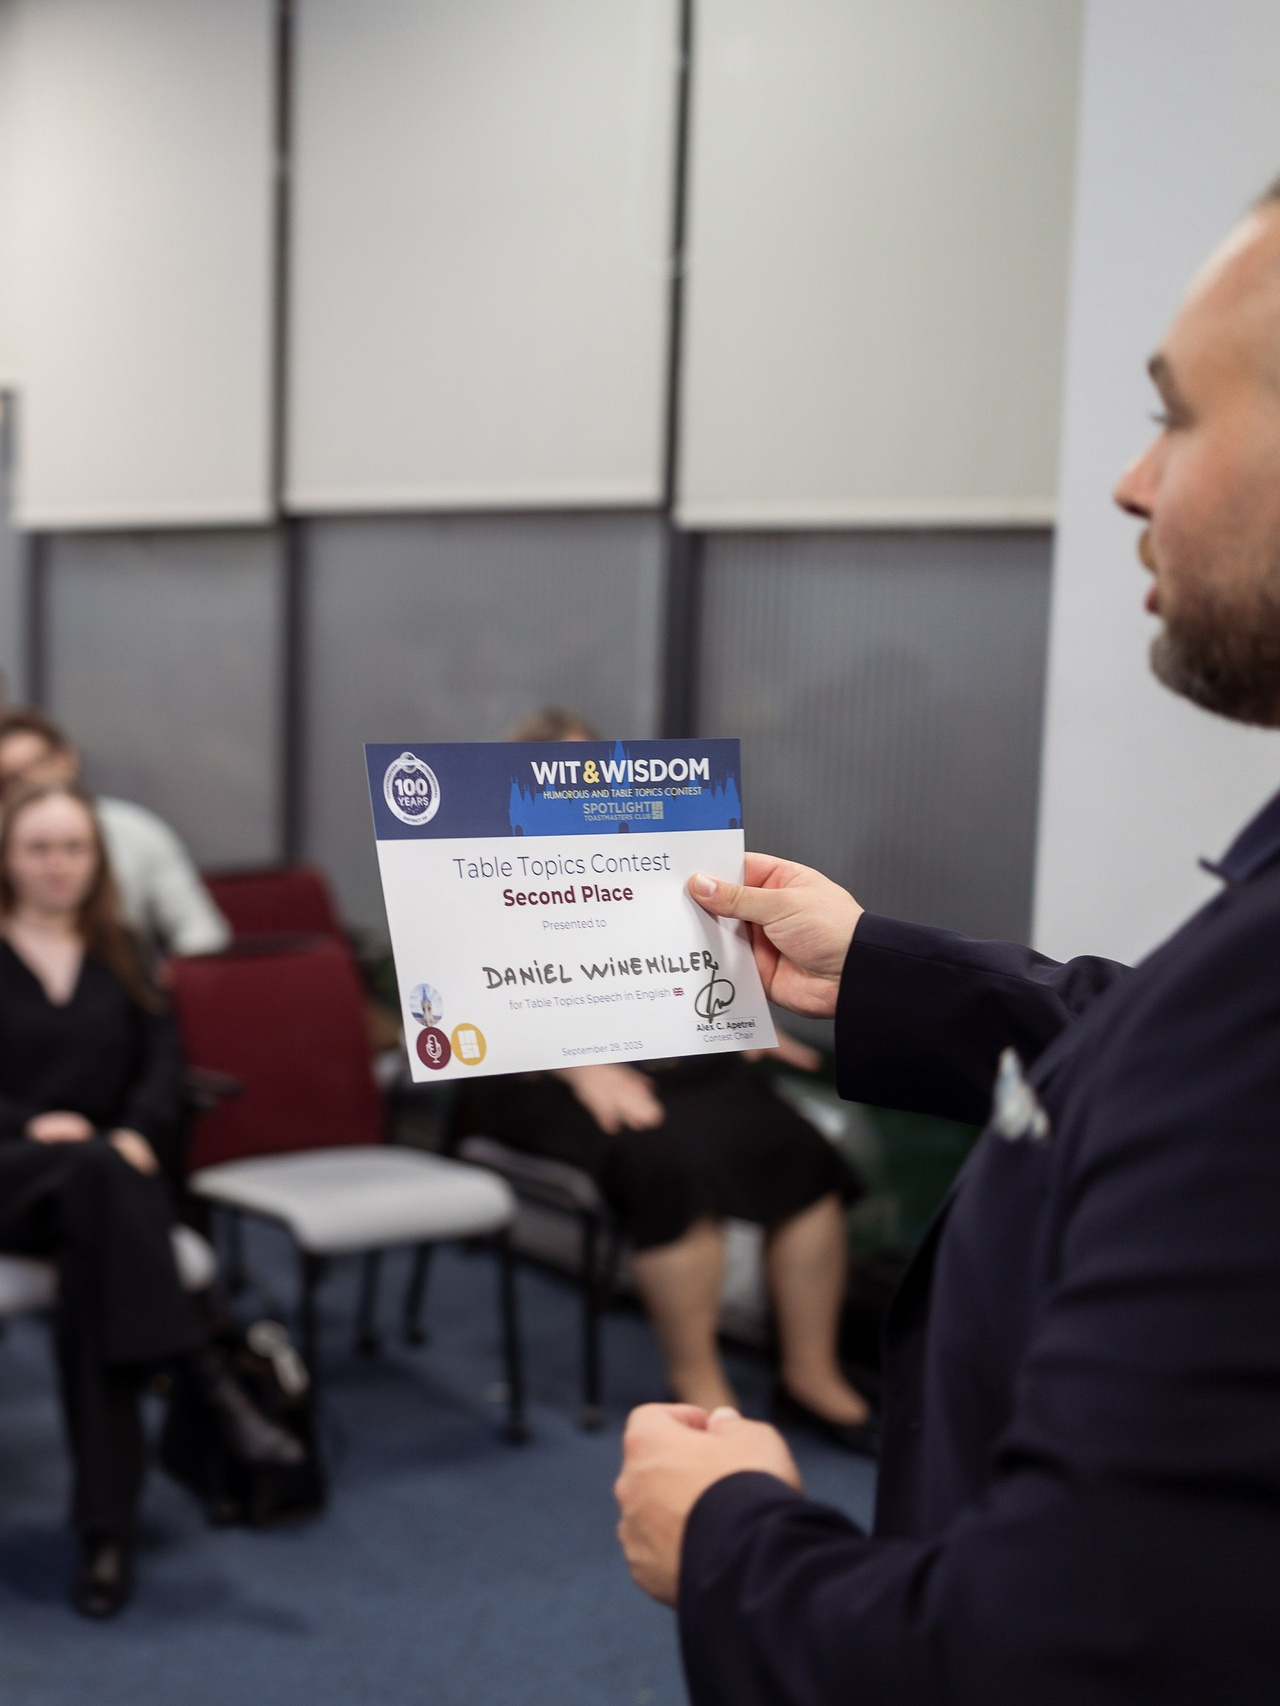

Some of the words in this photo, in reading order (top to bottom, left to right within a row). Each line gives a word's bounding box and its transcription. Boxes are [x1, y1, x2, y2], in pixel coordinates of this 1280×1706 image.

[531, 758, 710, 785] WIT&WISDOM
[395, 778, 428, 797] 100
[543, 789, 589, 800] HUMOROUS
[591, 788, 610, 799] AND
[611, 788, 633, 798] TABLE
[635, 787, 663, 798] TOPICS
[664, 786, 703, 797] CONTEST
[397, 796, 429, 807] YEARS
[583, 801, 651, 815] SPOTLIGHT
[584, 813, 634, 822] TOASTMASTERS
[634, 812, 652, 820] CLUB
[453, 857, 513, 879] Table
[517, 854, 586, 880] Topics
[591, 852, 671, 873] Contest
[503, 886, 576, 907] Second
[582, 884, 634, 903] Place
[542, 919, 594, 931] Presented
[596, 918, 608, 929] to
[509, 1001, 523, 1010] for
[525, 999, 552, 1009] Table
[554, 996, 586, 1008] Topics
[587, 992, 623, 1005] Speech
[624, 991, 634, 1001] in
[636, 988, 671, 1001] English
[697, 1023, 715, 1032] Alex
[716, 1022, 725, 1030] C.
[703, 1033, 733, 1043] Contest
[734, 1031, 754, 1040] Chair
[561, 1045, 608, 1057] September
[623, 1041, 644, 1051] 2025
